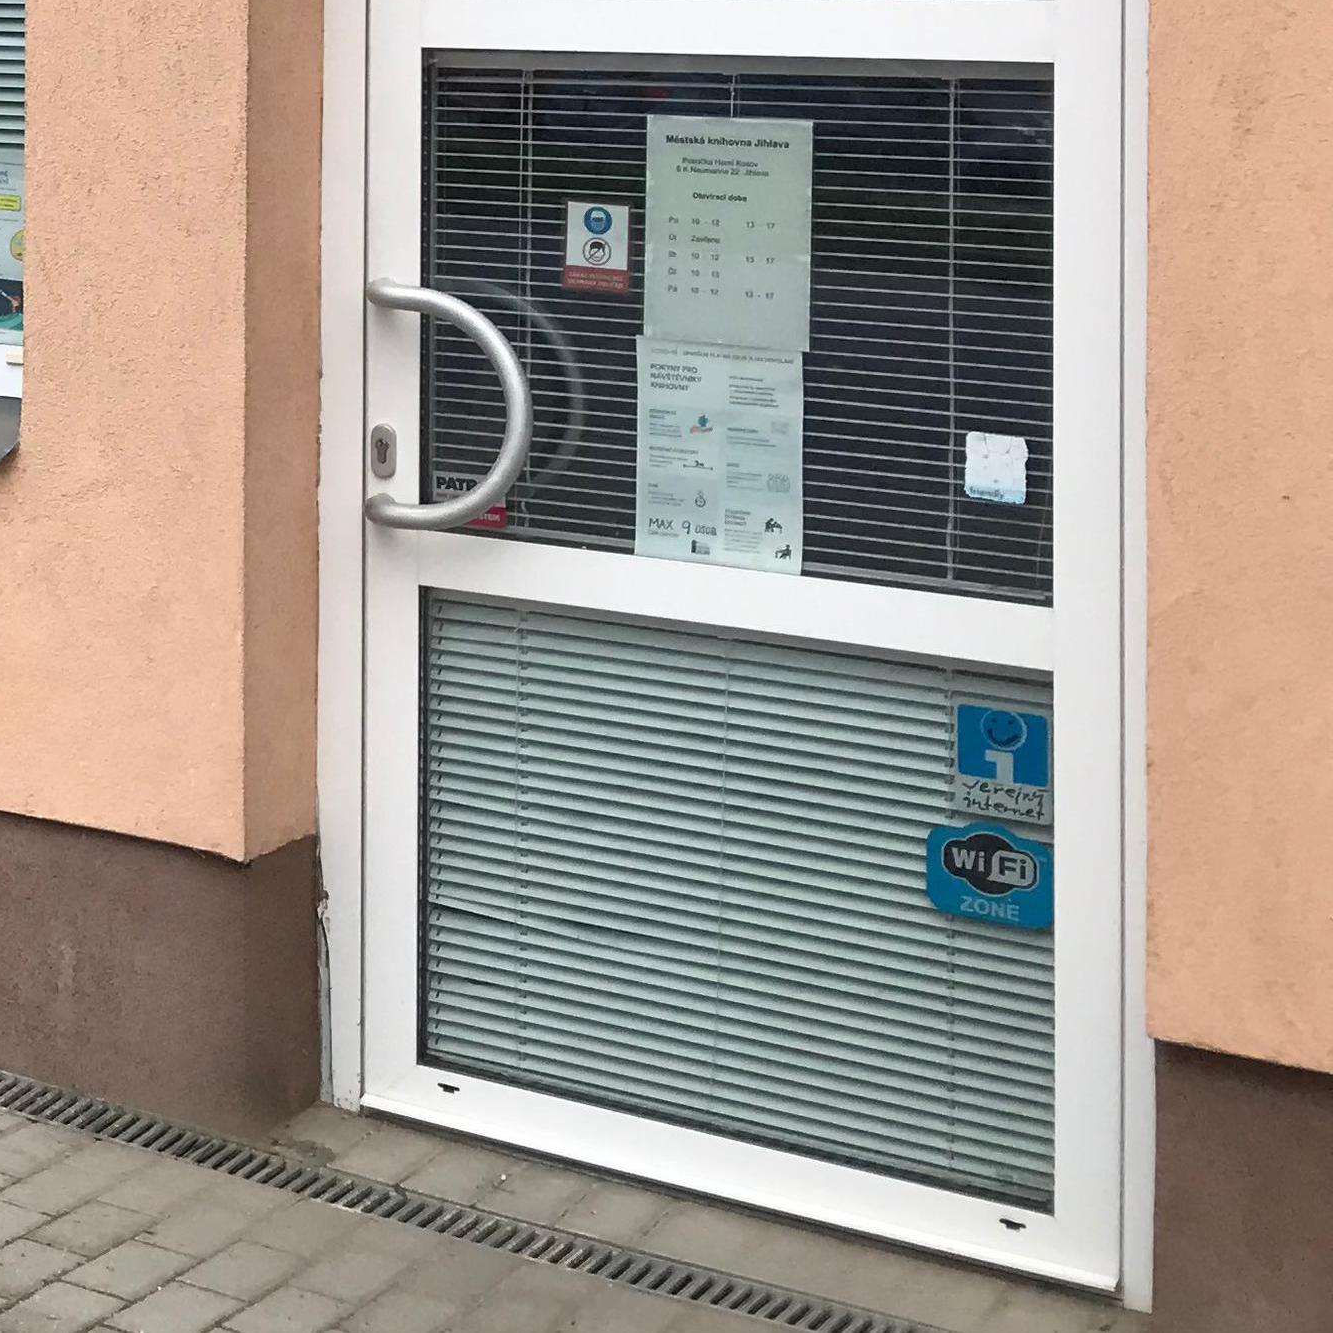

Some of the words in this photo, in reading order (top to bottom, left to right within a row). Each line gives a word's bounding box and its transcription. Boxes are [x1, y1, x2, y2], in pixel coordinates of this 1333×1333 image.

[665, 134, 706, 146] Městská
[707, 136, 752, 148] knihovna
[754, 138, 790, 149] Jihlava
[648, 517, 674, 531] MAX
[681, 519, 691, 535] 9
[962, 790, 1045, 821] internet
[960, 895, 1021, 922] ZONE
